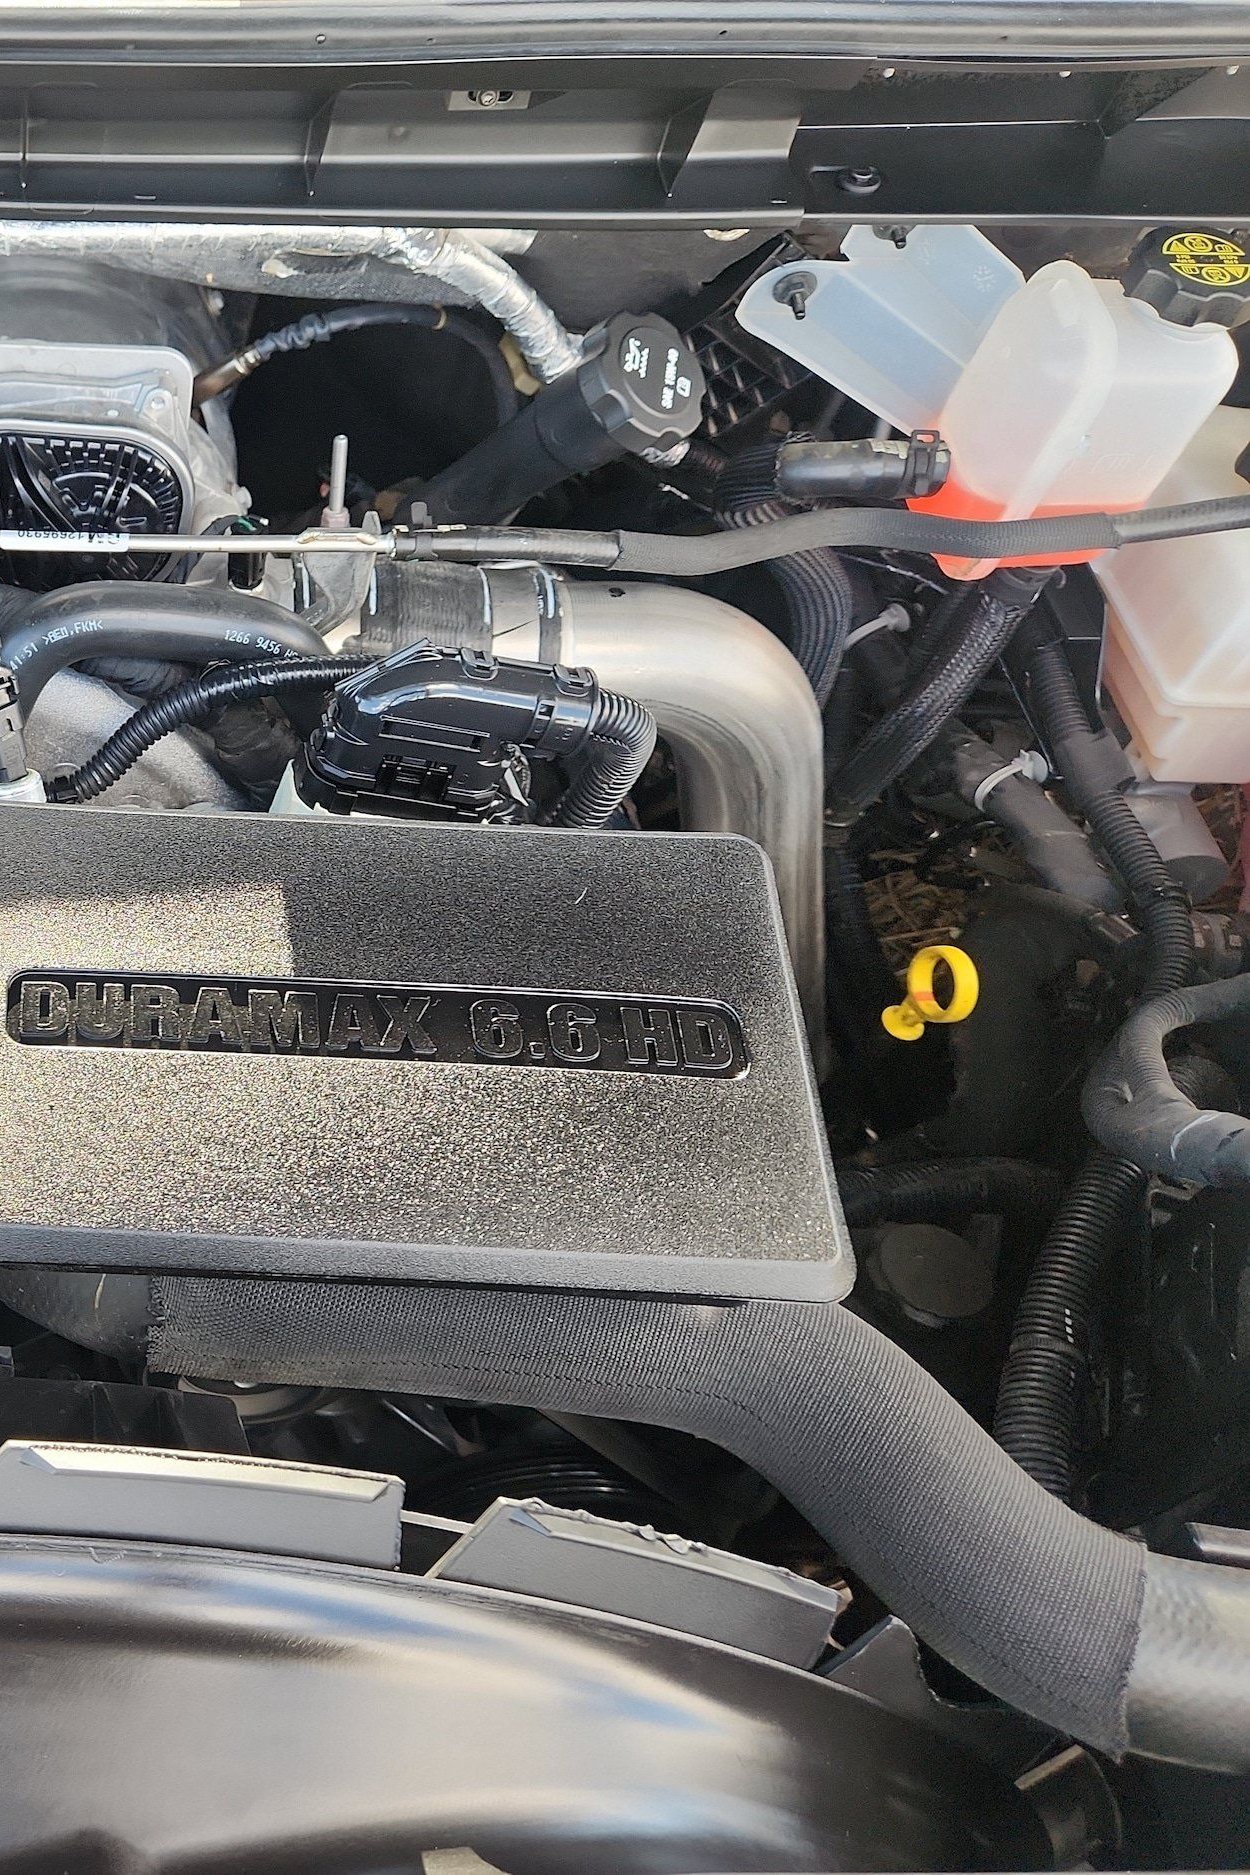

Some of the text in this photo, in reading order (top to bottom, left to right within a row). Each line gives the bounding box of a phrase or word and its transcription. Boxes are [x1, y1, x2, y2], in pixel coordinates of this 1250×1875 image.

[224, 629, 251, 645] 1266
[255, 637, 283, 655] 9456
[19, 982, 733, 1069] DURAMAX 6.6 HD
